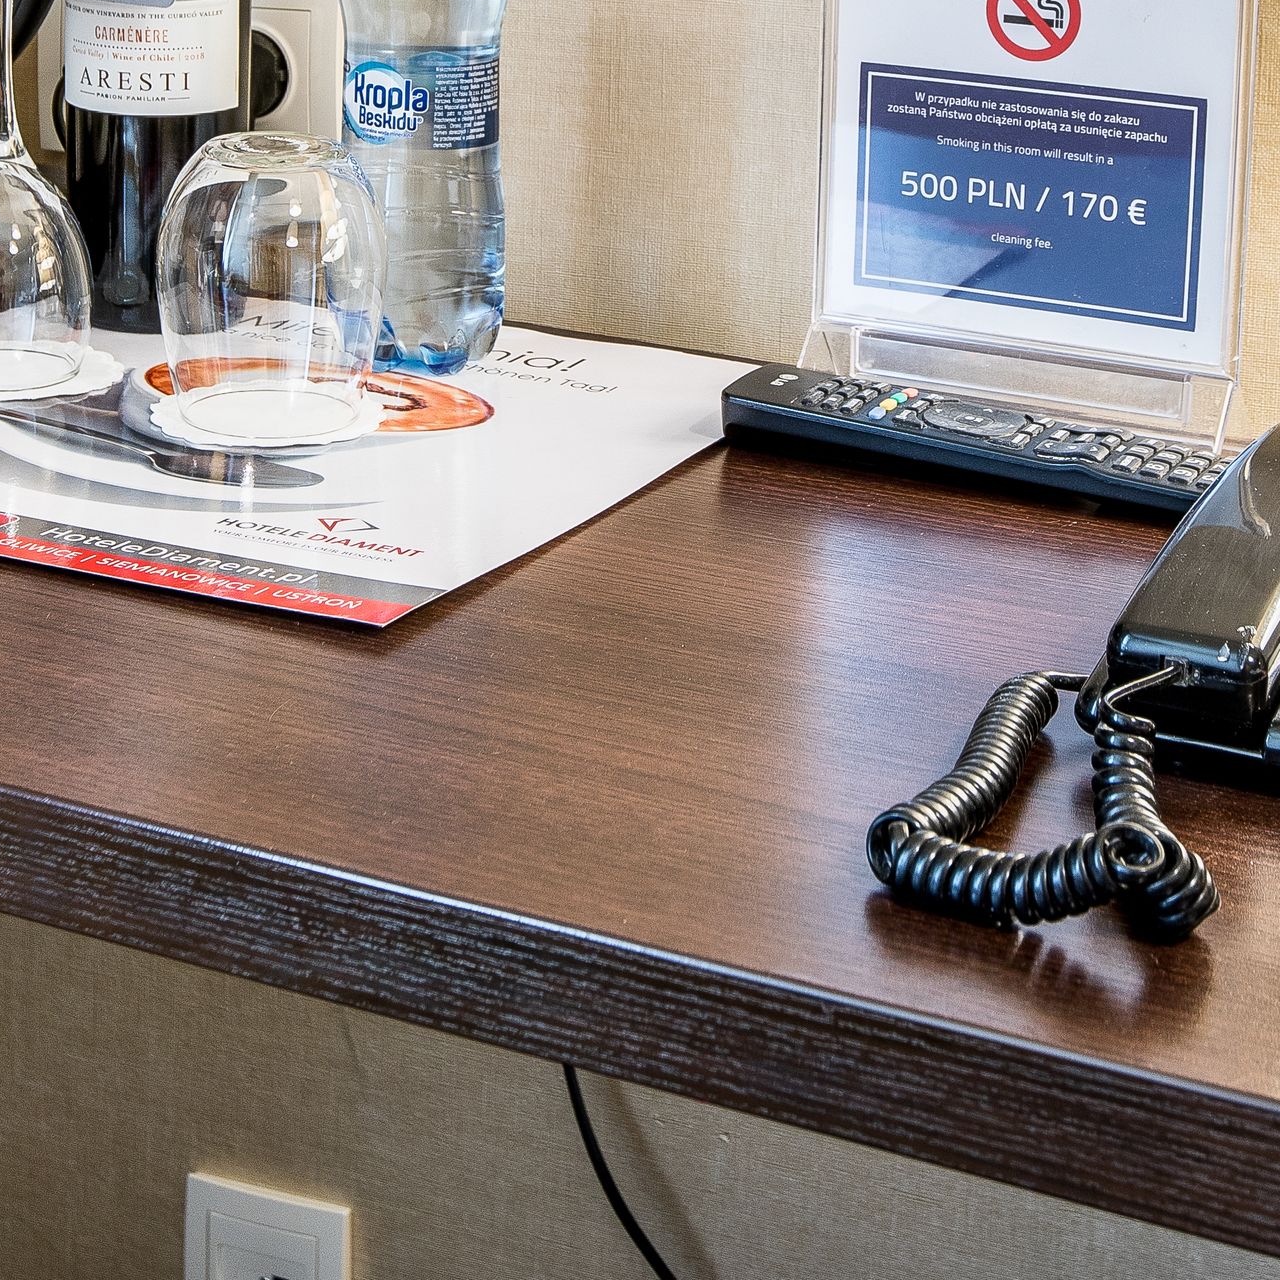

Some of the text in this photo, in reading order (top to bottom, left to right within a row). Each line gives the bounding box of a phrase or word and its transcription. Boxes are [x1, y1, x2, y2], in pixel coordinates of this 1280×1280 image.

[82, 7, 95, 15] OWN
[96, 10, 135, 19] VINEYARDS
[199, 9, 223, 17] VALLEY
[112, 52, 133, 61] Wine
[136, 52, 146, 61] of
[149, 52, 175, 61] Chile
[184, 52, 205, 61] 2018
[80, 66, 190, 91] ARESTI
[354, 72, 428, 114] Kropla
[359, 105, 417, 131] Beskidu
[915, 91, 1140, 126] W przypadku nie zastosowania się do zakazu
[887, 104, 1168, 144] zostaną Państwo obciążeni opłatą za usunięcie zapachu
[937, 135, 1114, 165] Smoking in this room will result in a
[901, 170, 1147, 225] 500 PLN / 170 €
[991, 232, 1053, 249] cleaning fee.
[486, 349, 587, 372] nia!
[560, 378, 618, 393] Tag!
[216, 517, 425, 558] HOTELE DIAMENT
[243, 532, 298, 547] COMFORT
[341, 550, 394, 563] BUSINESS
[39, 527, 319, 585] HoteleDiament.pl
[95, 557, 255, 592] SIEMIANOWICE
[272, 589, 363, 609] USTROŃ
